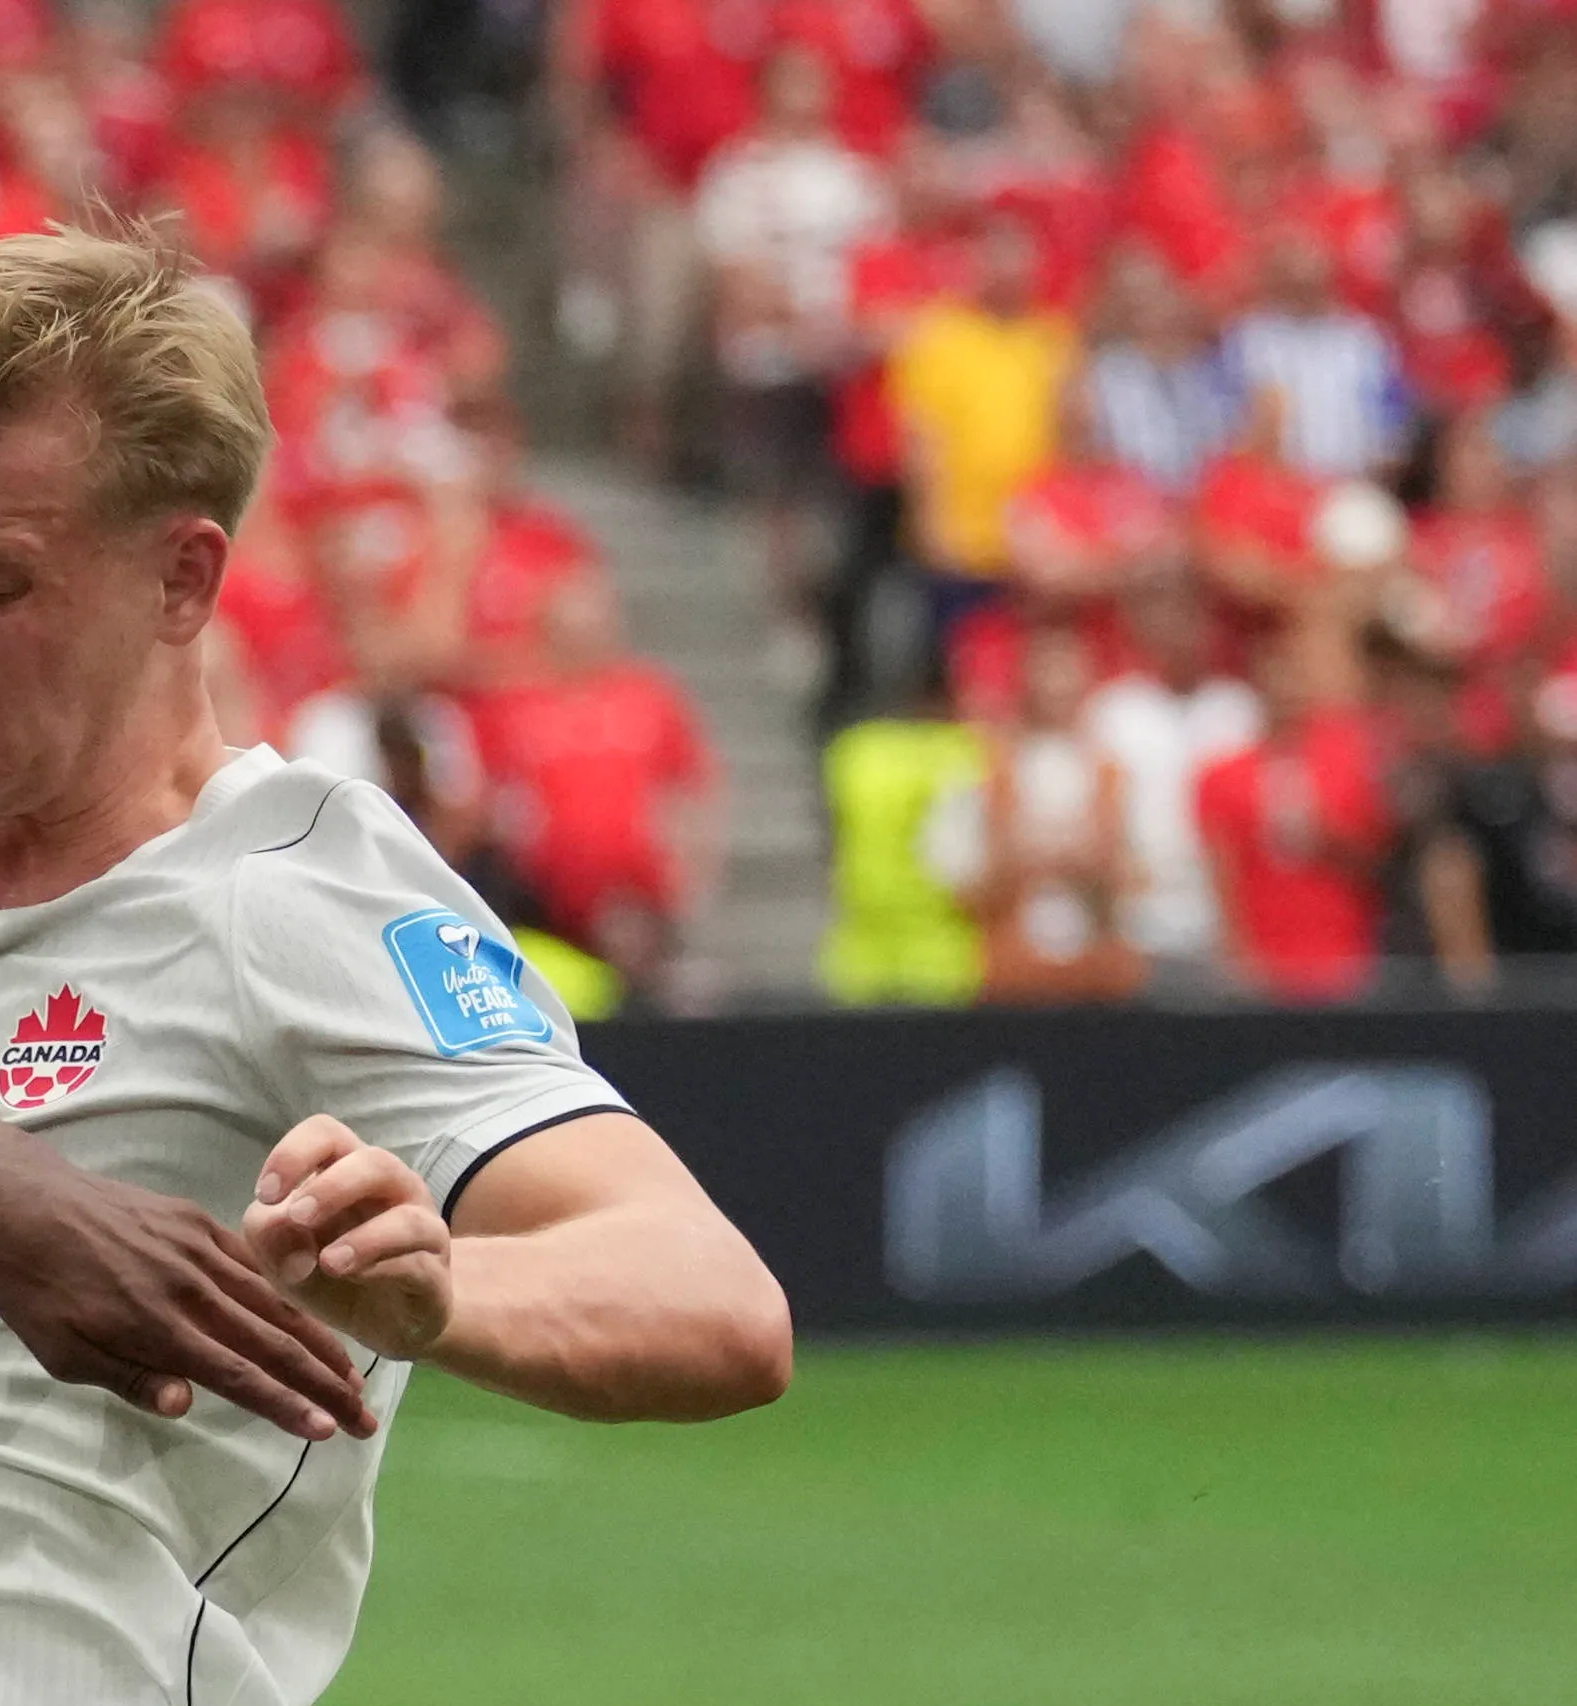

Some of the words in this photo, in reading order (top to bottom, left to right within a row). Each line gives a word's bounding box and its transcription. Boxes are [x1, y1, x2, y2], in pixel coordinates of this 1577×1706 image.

[456, 985, 518, 1018] PEACE
[479, 1012, 515, 1029] FIFA
[2, 1045, 101, 1065] CANADA
